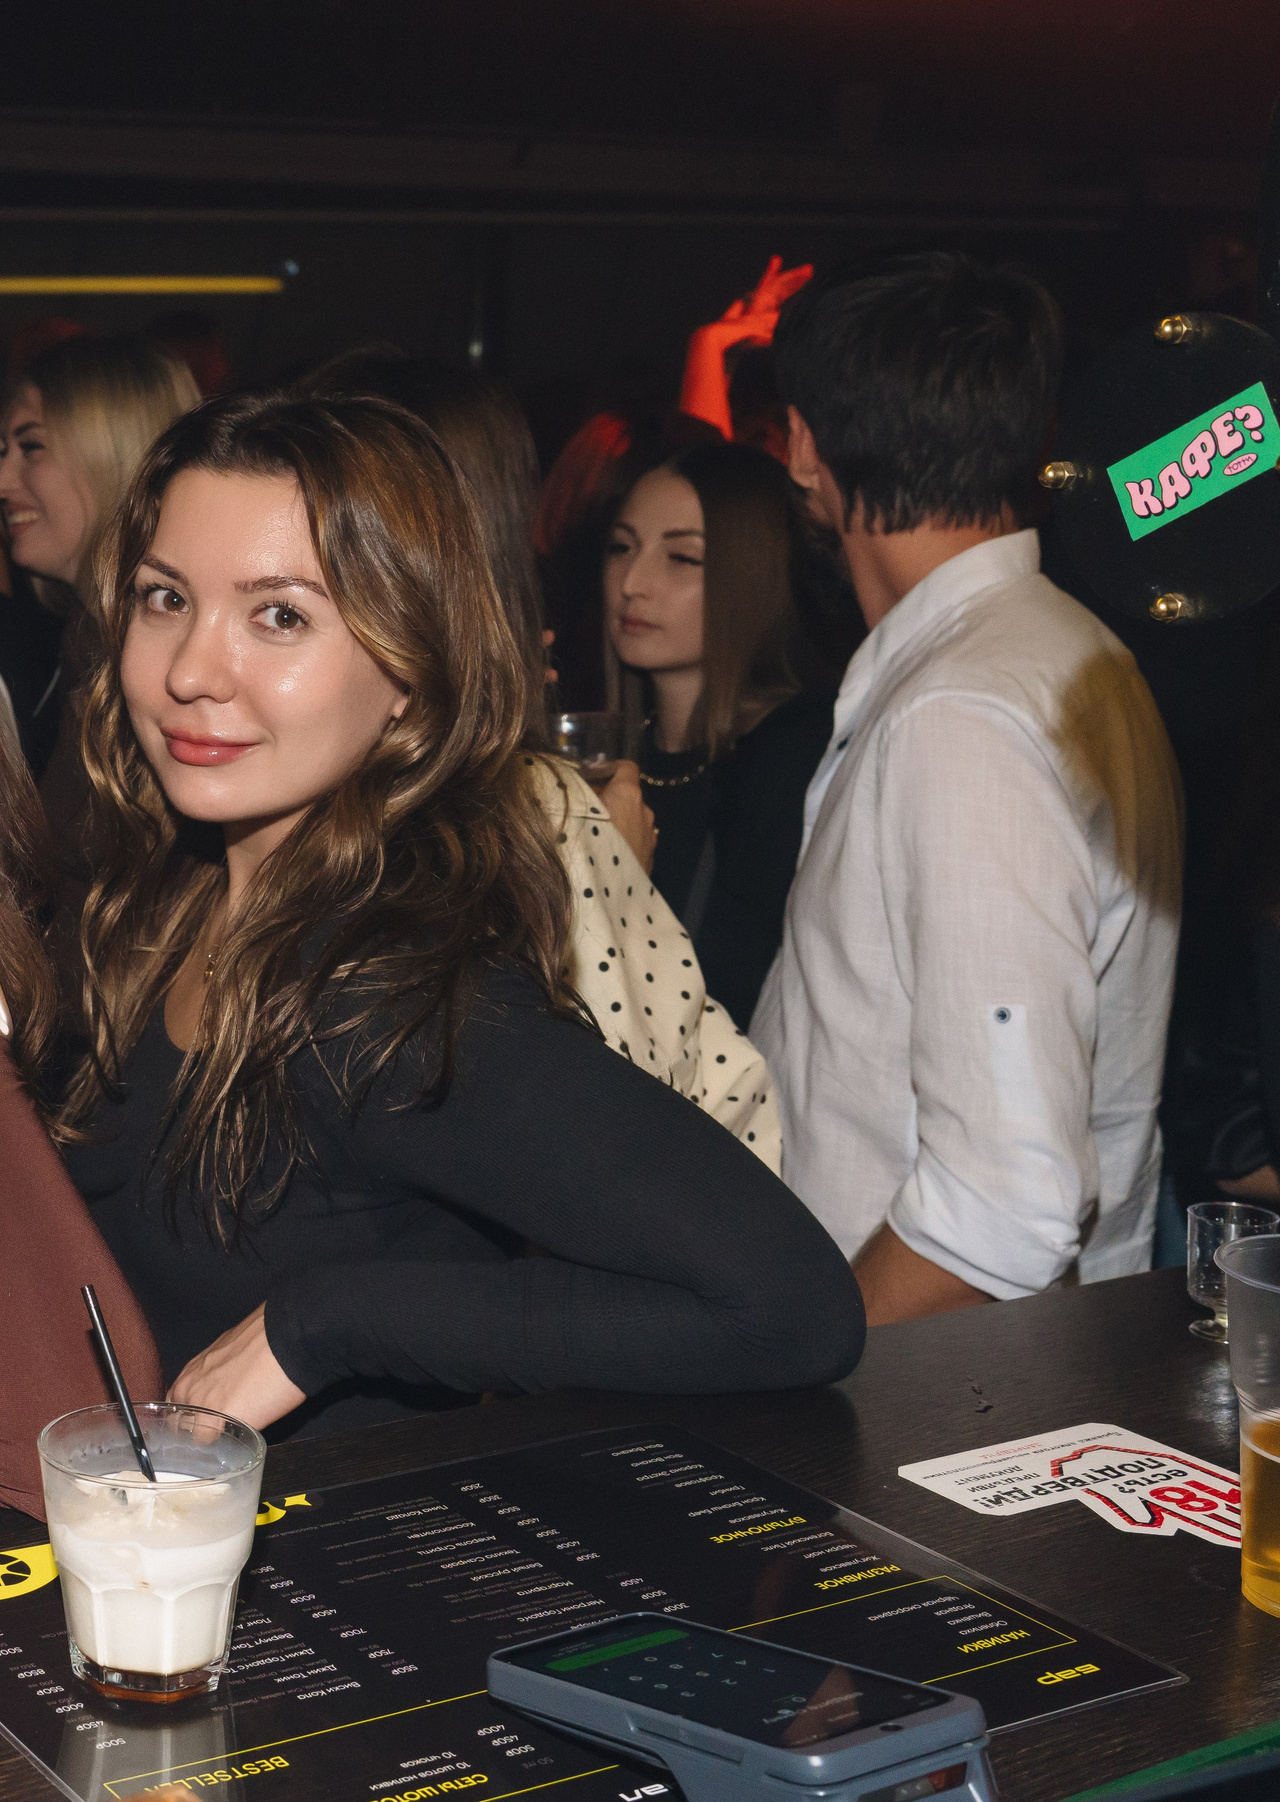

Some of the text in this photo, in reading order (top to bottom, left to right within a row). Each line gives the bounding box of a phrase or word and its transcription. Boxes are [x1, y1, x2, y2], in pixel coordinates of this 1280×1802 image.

[1125, 404, 1265, 519] КАФЕ?
[636, 1471, 670, 1481] Экстра
[669, 1464, 704, 1474] Корона
[953, 1464, 1024, 1487] ДОКУМЕНТ
[966, 1471, 1041, 1494] ПРЕДЪЯВИ
[972, 1456, 1167, 1510] ПОДТВЕРДИ!
[1111, 1468, 1188, 1494] есть?
[1148, 1478, 1240, 1513] 18
[386, 1510, 423, 1520] Колада
[422, 1505, 448, 1513] Пина
[407, 1522, 475, 1539] Космополитен
[709, 1516, 807, 1544] БУТЫЛОЧНОЕ
[417, 1535, 496, 1555] Апероль Спритц
[785, 1531, 834, 1546] Богемский
[761, 1543, 787, 1551] Пилс
[803, 1550, 825, 1559] найт
[825, 1544, 857, 1553] Черри
[440, 1549, 520, 1569] Текила Санрайз
[470, 1562, 543, 1581] Белый русский
[814, 1564, 901, 1590] РАЗЛИВНОЕ
[516, 1581, 574, 1596] Маргарита
[561, 1599, 605, 1612] Негрони
[868, 1604, 922, 1621] смородина
[934, 1603, 975, 1616] Ягодная
[247, 1617, 272, 1627] Лонг
[947, 1611, 992, 1625] Вишенка
[959, 1620, 1008, 1635] Облепиха
[254, 1632, 294, 1645] Вермут
[957, 1629, 1030, 1653] НАЛИВКИ
[285, 1648, 315, 1659] Джин
[274, 1664, 337, 1683] Джин Тоник
[297, 1681, 361, 1700] Виски Кола
[400, 1751, 457, 1768] 10 чпоков
[522, 1757, 554, 1769] 50 ml
[144, 1755, 290, 1793] BESTSELL
[418, 1765, 455, 1777] шотов
[369, 1775, 418, 1790] наливки
[437, 1774, 488, 1792] СЕТЫ
